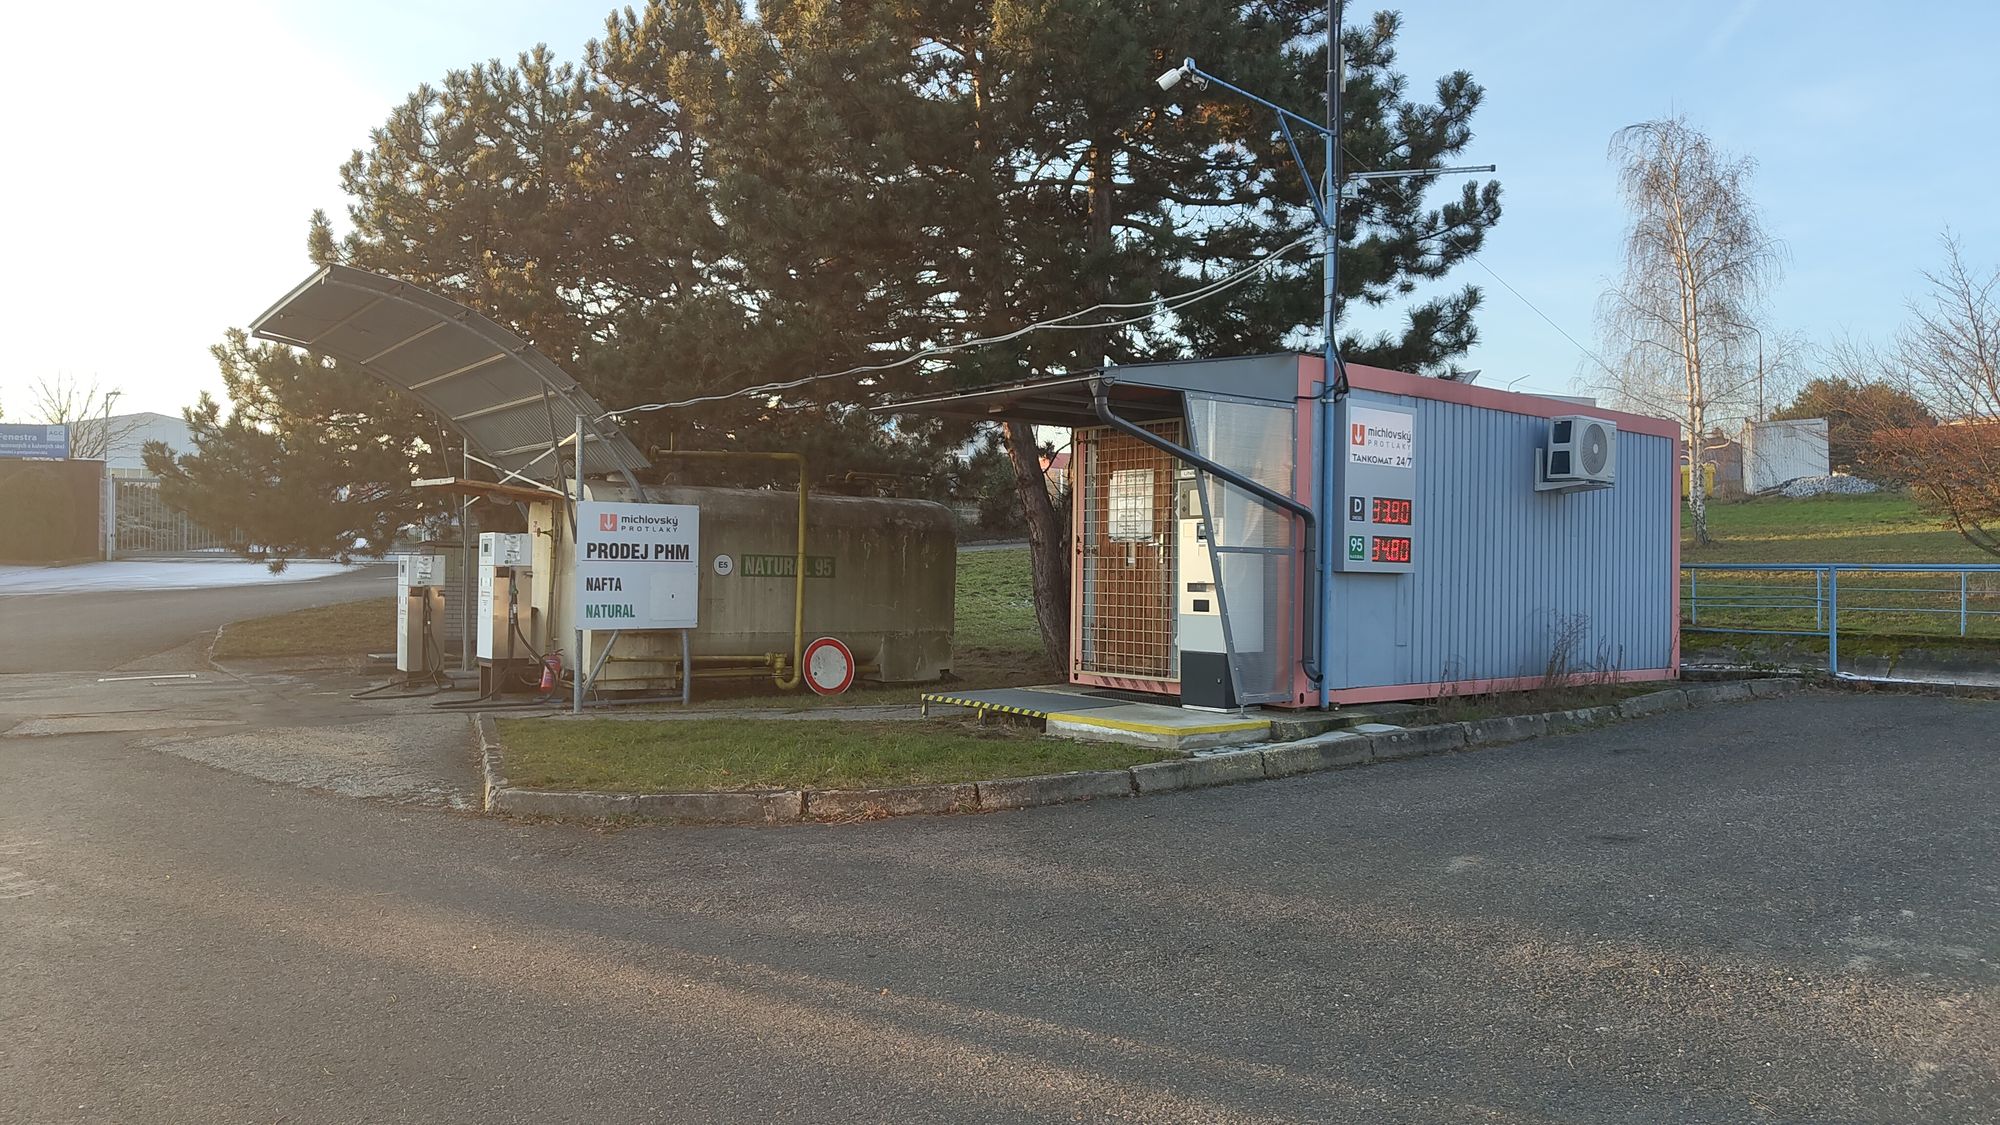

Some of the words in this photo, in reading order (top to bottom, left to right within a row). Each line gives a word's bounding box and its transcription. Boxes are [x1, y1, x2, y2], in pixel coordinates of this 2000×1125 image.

[1368, 427, 1411, 443] michlovský
[1367, 440, 1411, 450] PROTLAKY
[1352, 453, 1393, 465] TANKOMAT
[1396, 456, 1413, 468] 24/7
[1354, 498, 1362, 513] D
[620, 515, 679, 527] michlovský
[621, 525, 678, 533] PROTLAKY
[586, 542, 649, 560] PRODEJ
[654, 544, 690, 560] PHM
[1350, 537, 1363, 552] 95
[718, 561, 729, 569] E5
[815, 558, 833, 577] 95
[585, 577, 622, 592] NAFTA
[585, 604, 636, 619] NATURAL
